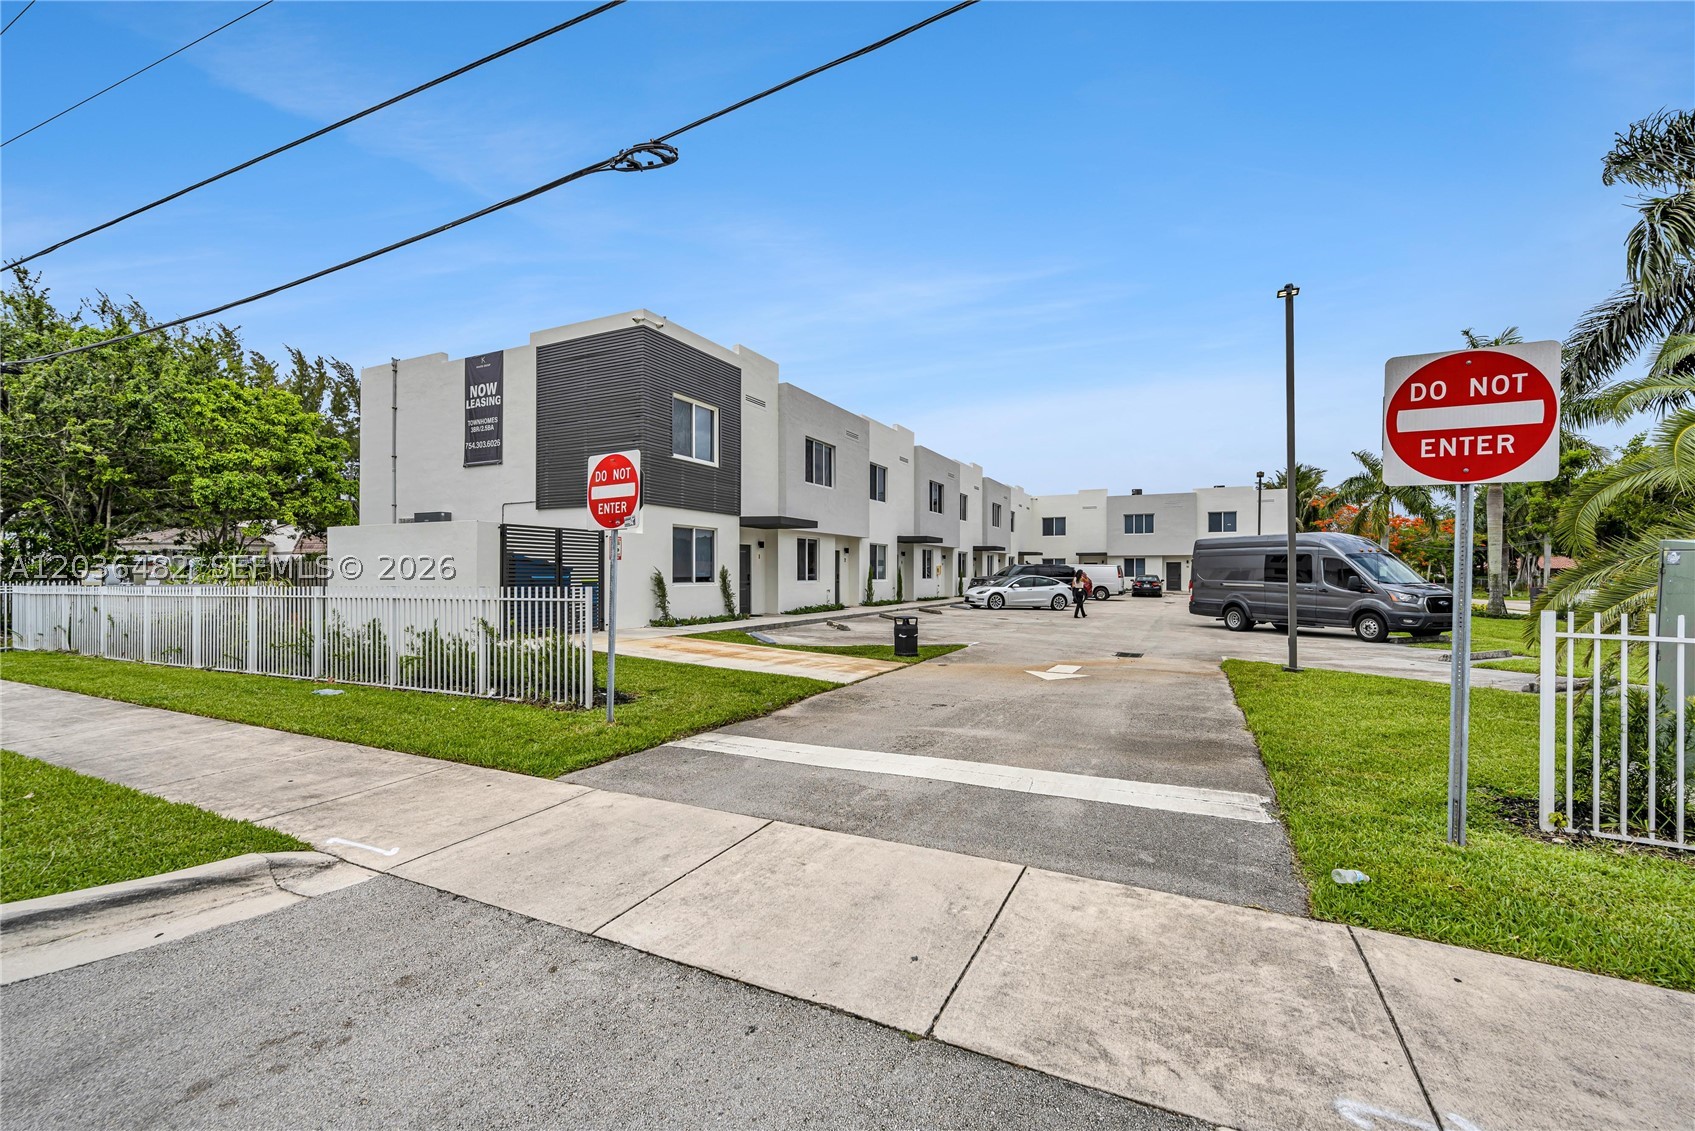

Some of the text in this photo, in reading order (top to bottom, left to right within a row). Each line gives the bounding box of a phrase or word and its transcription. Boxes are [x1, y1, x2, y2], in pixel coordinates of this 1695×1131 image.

[470, 382, 498, 398] NOW
[1410, 372, 1529, 402] DO NOT
[466, 396, 501, 409] LEASING
[468, 416, 498, 426] TOWNHOMES
[1420, 434, 1515, 458] ENTER
[595, 467, 631, 482] DO NOT
[598, 502, 627, 514] ENTER
